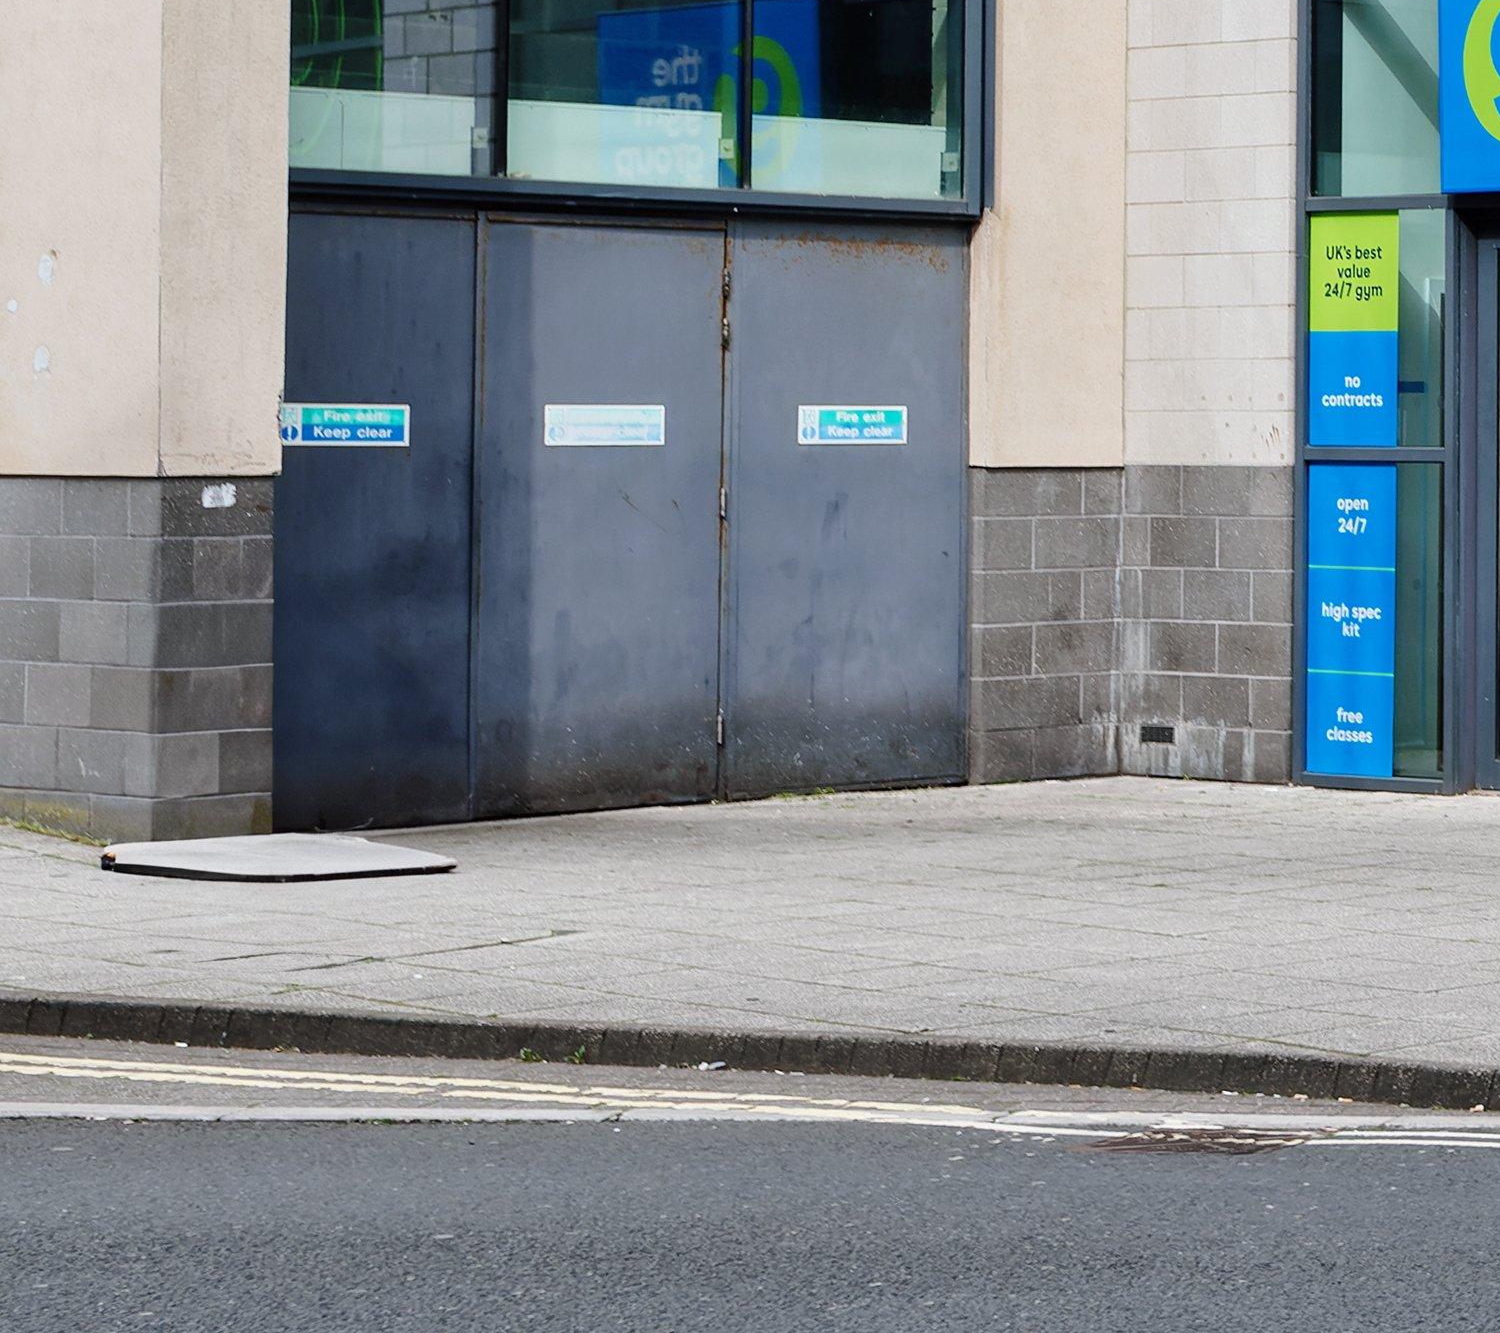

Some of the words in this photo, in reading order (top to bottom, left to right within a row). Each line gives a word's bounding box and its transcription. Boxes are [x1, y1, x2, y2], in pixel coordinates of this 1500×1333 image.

[1325, 245, 1352, 261] UK's
[1355, 245, 1383, 260] best
[1337, 264, 1371, 279] value
[1324, 281, 1352, 299] 24/7
[1355, 284, 1383, 302] gym
[1344, 376, 1361, 389] no
[1321, 392, 1383, 408] contracts
[835, 411, 859, 423] Fire
[862, 411, 886, 423] exit
[313, 425, 351, 440] Keep
[356, 426, 393, 439] clear
[827, 425, 860, 438] Keep
[862, 425, 894, 438] clear
[1336, 497, 1369, 515] open
[1337, 516, 1367, 536] 24/7
[1321, 601, 1350, 623] high
[1351, 605, 1382, 623] spec
[1342, 621, 1361, 637] kit
[1336, 706, 1364, 725] free
[1326, 725, 1374, 744] classes
